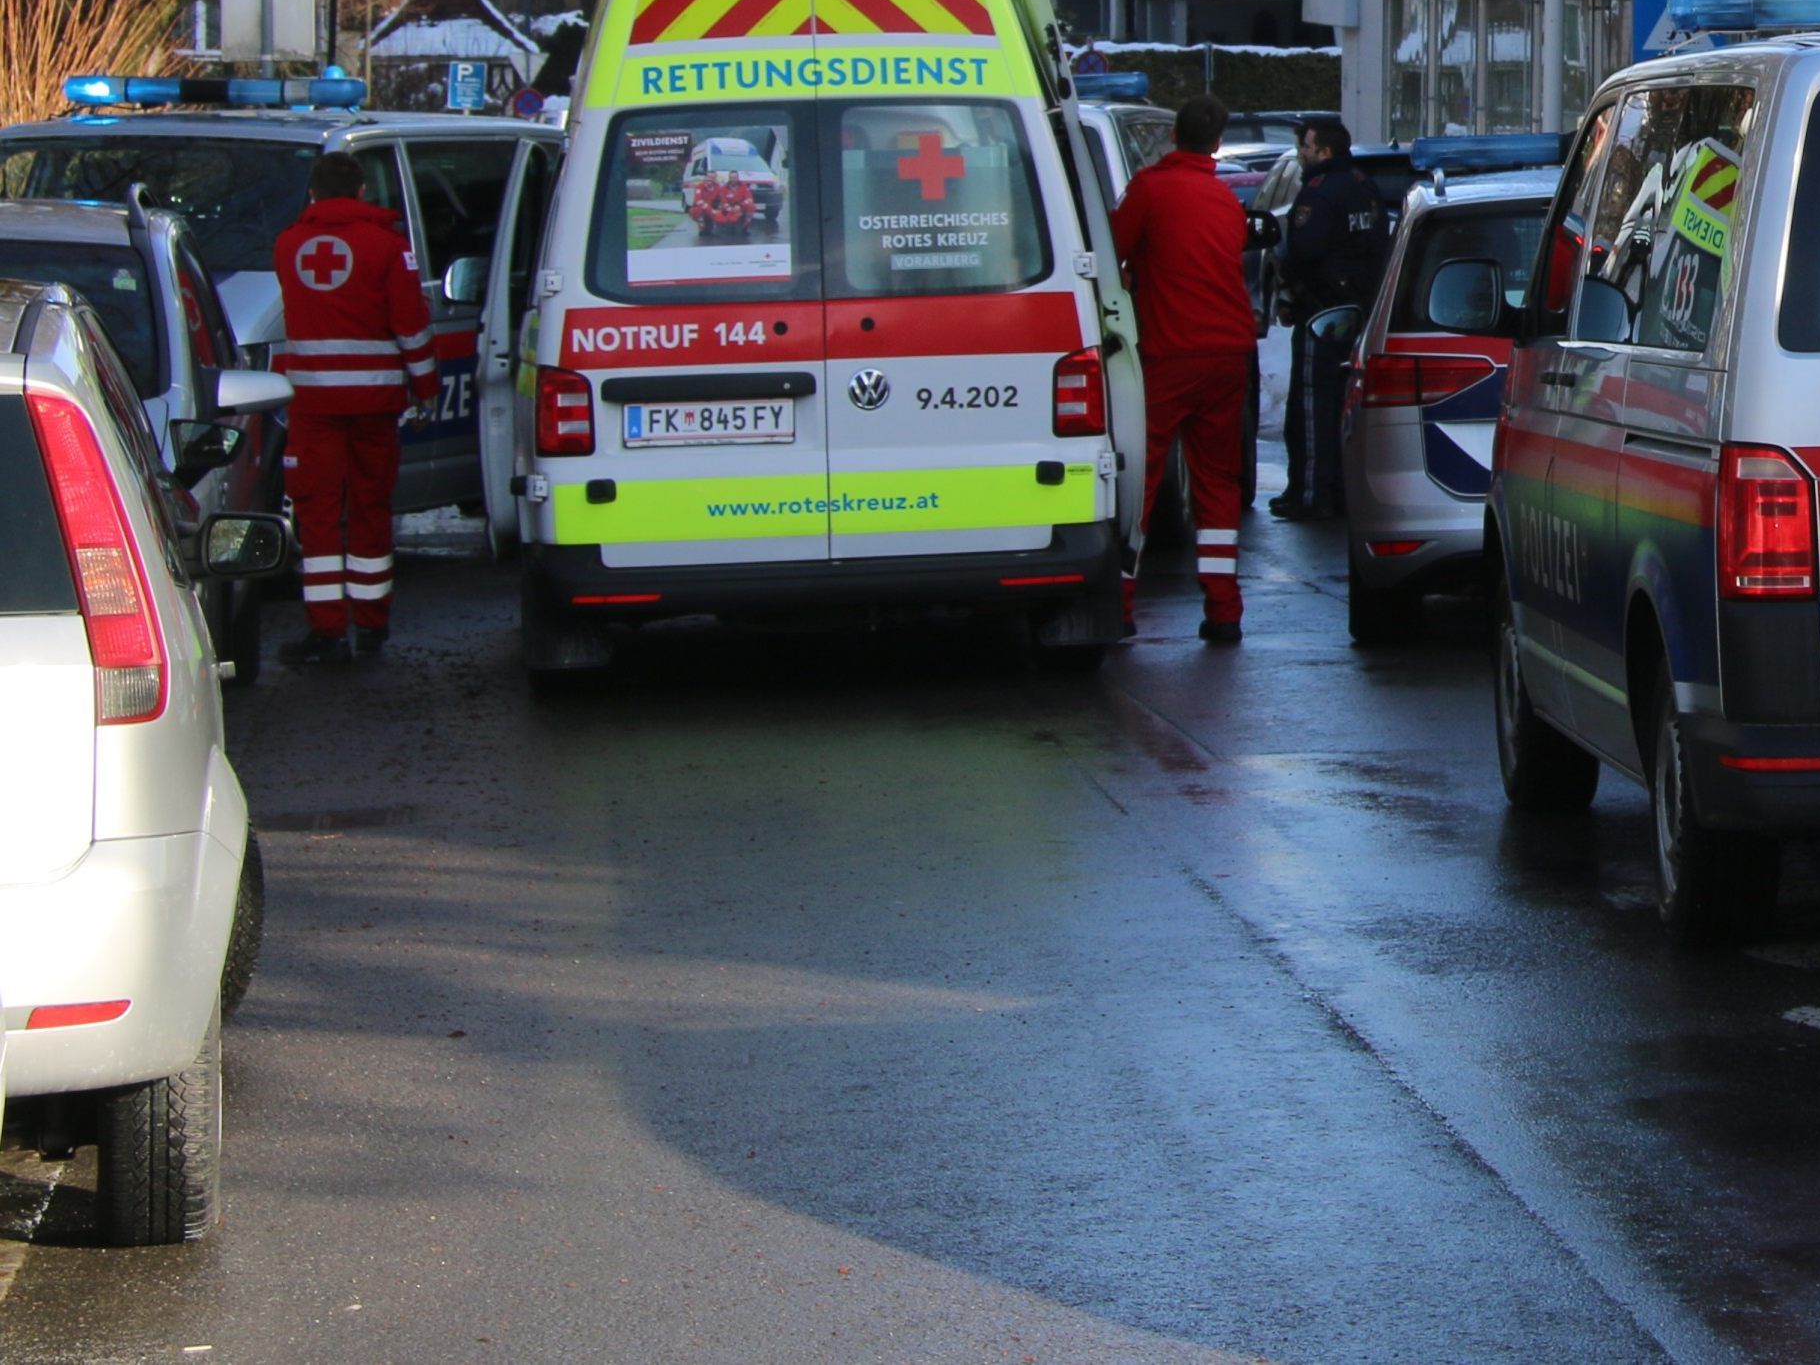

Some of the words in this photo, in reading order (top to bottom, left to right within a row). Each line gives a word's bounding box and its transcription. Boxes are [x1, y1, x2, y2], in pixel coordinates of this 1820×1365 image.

[457, 64, 473, 82] P
[642, 57, 988, 95] RETTUNGSDIENST
[631, 136, 689, 147] ZIVILDIENST
[859, 212, 1009, 230] ÖSTERREICHISCHES
[882, 233, 932, 249] ROTES
[937, 232, 989, 247] KREUZ
[894, 254, 980, 268] VORARLBERG
[572, 324, 699, 353] NOTRUF
[713, 321, 767, 347] 144
[916, 385, 1019, 411] 9.4.202
[649, 409, 680, 433] FK
[706, 492, 940, 518] www.roteskreuz.at
[1520, 501, 1581, 605] POLIZEI
